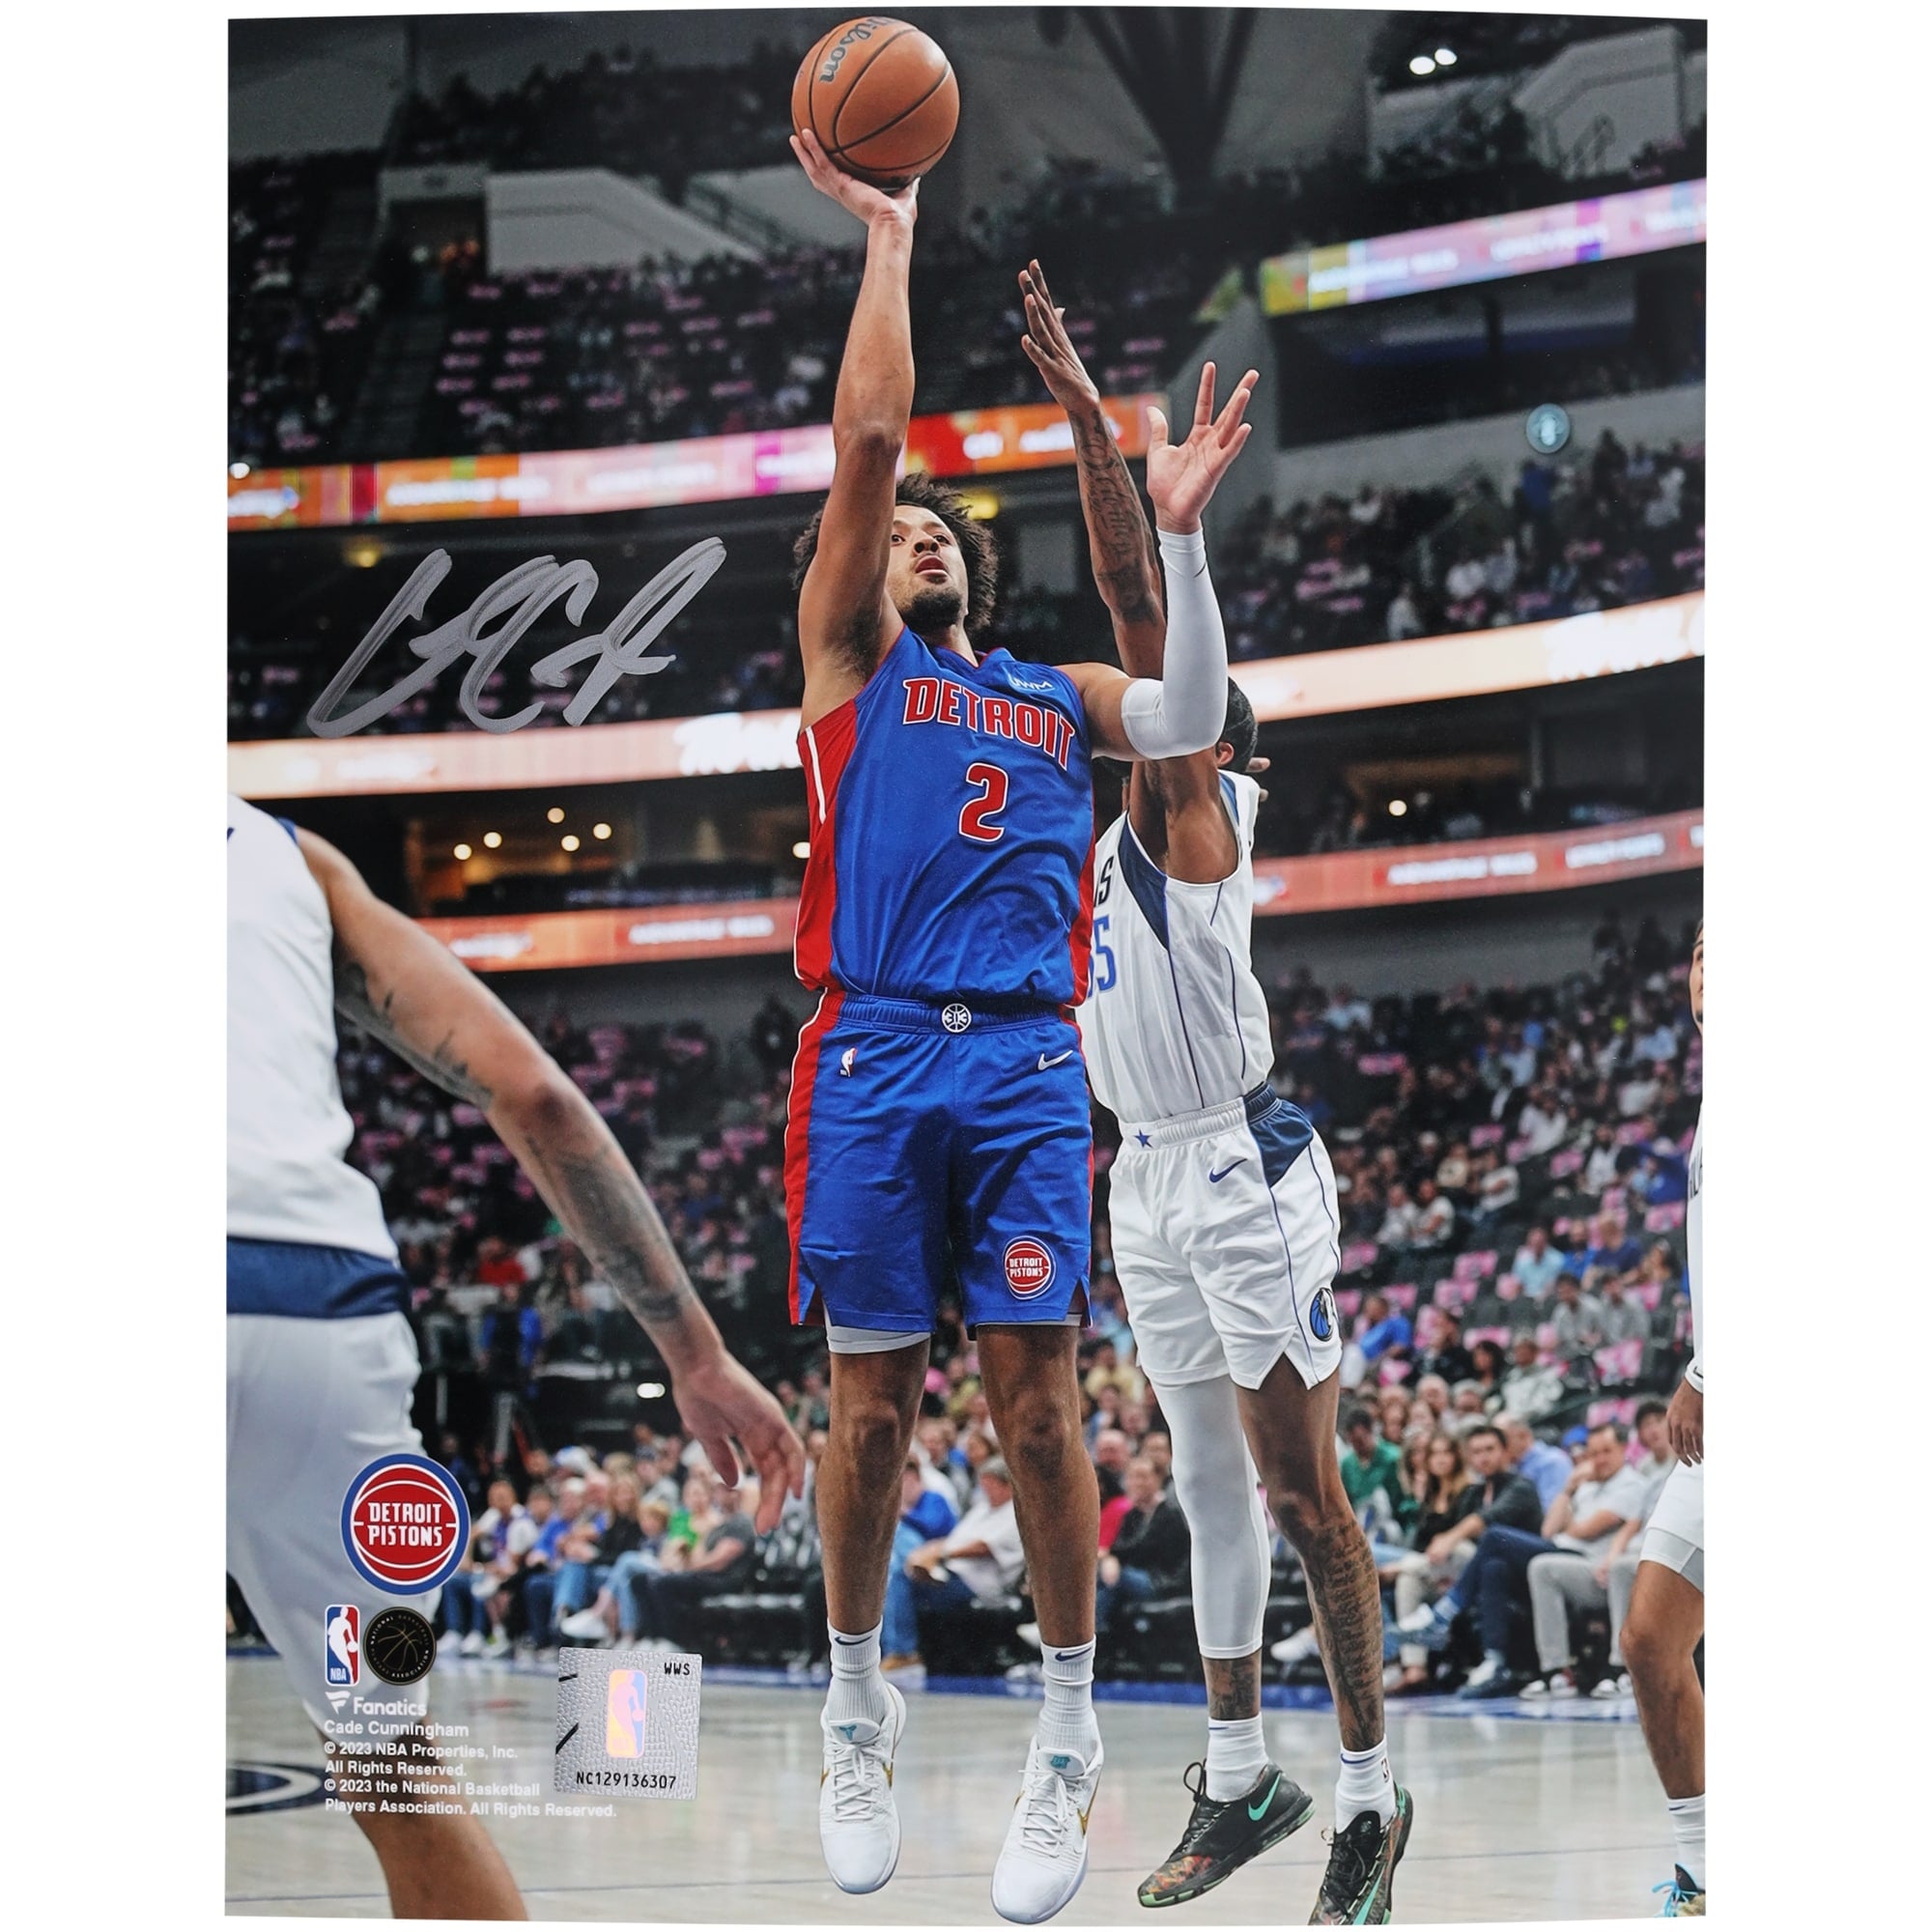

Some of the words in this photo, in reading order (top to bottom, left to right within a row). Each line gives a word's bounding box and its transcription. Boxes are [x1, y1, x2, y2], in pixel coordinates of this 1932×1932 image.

[1009, 673, 1053, 690] UWM
[902, 677, 1075, 771] DETROIT
[958, 762, 1009, 842] 2
[1009, 1257, 1043, 1267] DETROIT
[1009, 1266, 1043, 1277] PISTONS
[664, 1662, 691, 1675] WWS
[576, 1771, 677, 1790] NC129136307
